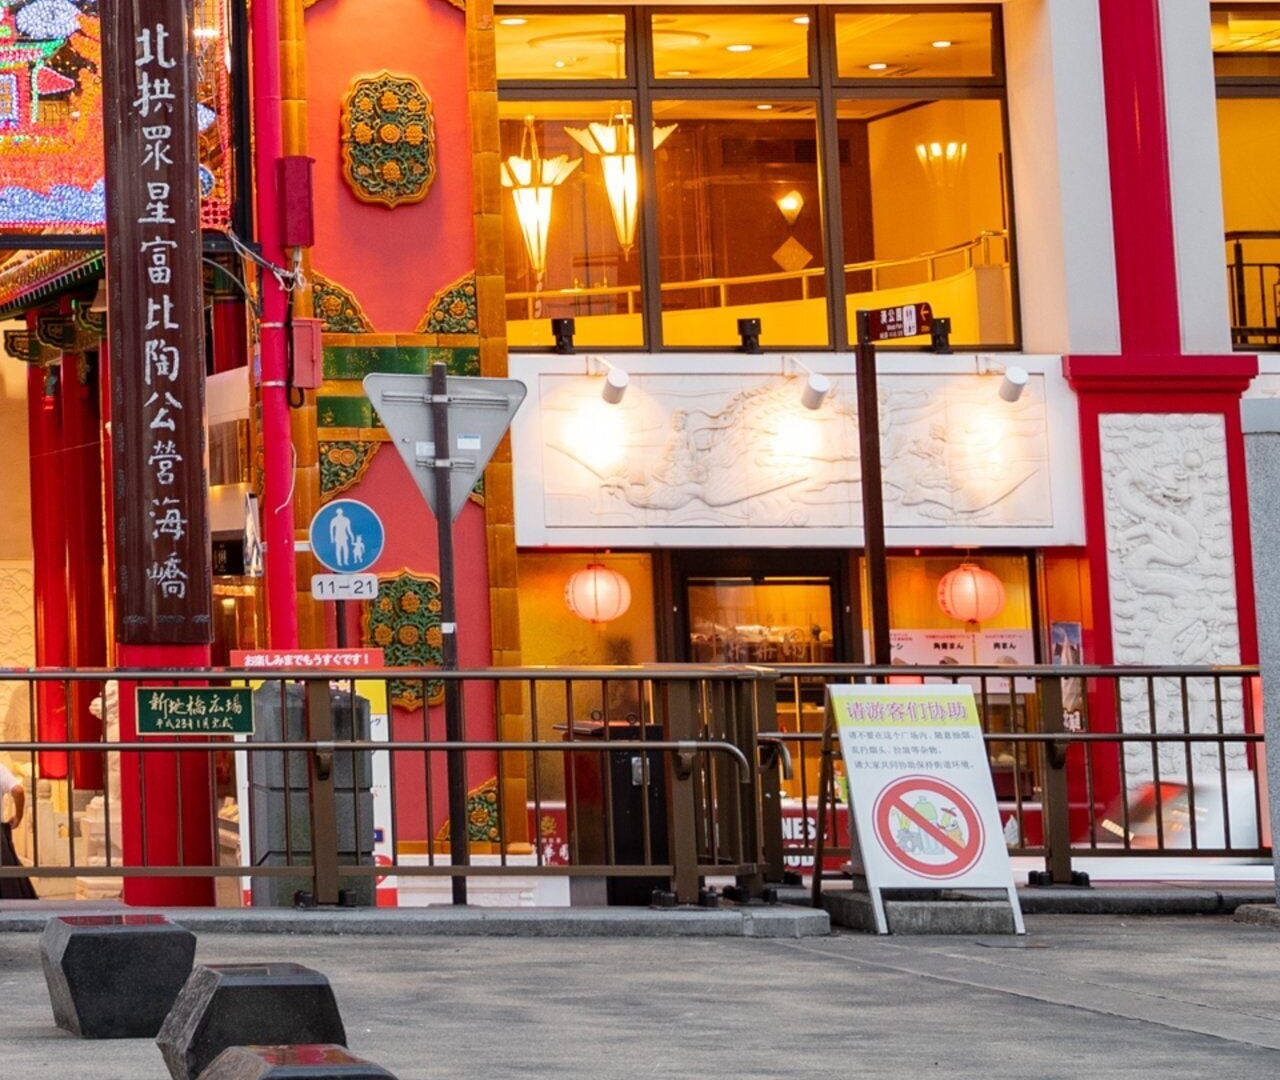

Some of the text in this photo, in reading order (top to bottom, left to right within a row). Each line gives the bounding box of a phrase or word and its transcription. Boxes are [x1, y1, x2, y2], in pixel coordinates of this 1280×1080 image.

[316, 580, 374, 595] 11-21
[148, 691, 244, 719] 新地橋広場
[846, 700, 968, 721] 请游客们协助
